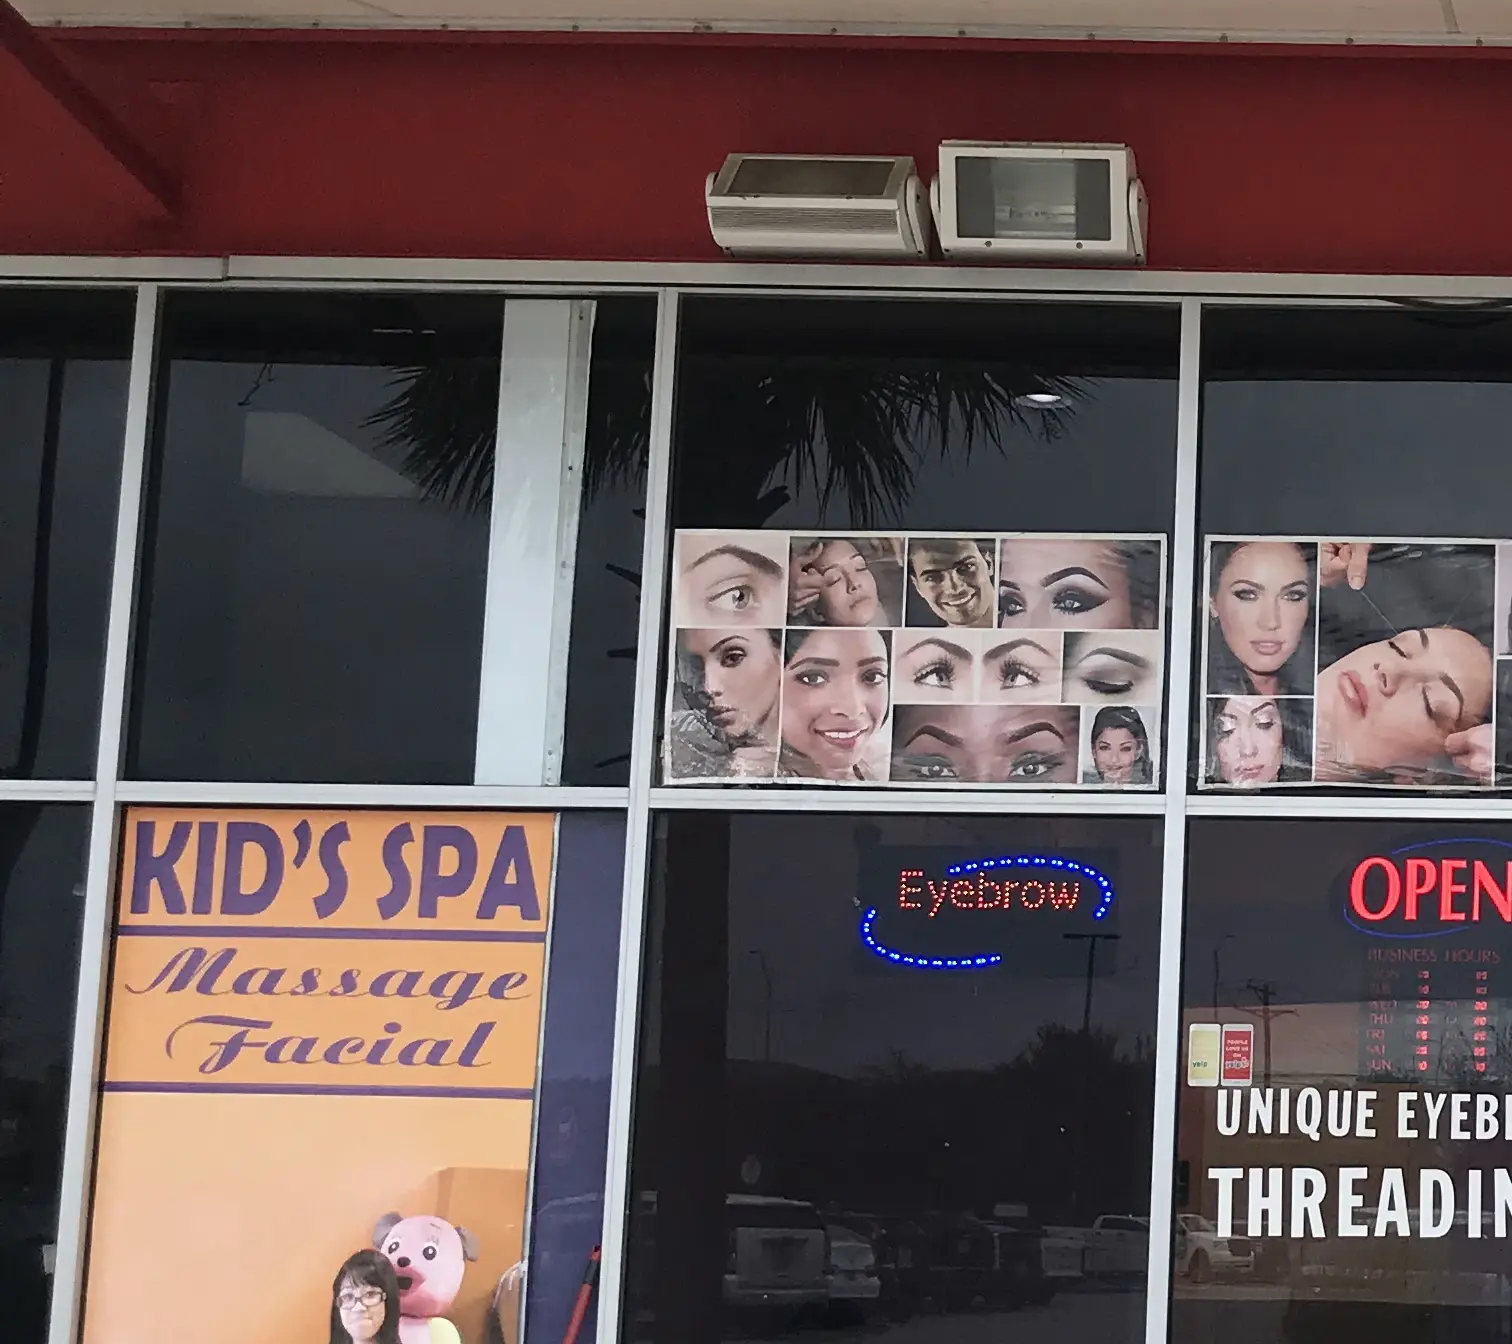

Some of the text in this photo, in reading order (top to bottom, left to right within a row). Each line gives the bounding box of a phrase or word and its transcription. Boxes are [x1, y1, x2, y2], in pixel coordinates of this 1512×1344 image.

[130, 819, 542, 921] KID'S SPA
[900, 868, 1080, 919] Eyebrow
[124, 947, 532, 1011] Massage
[165, 1014, 498, 1075] Facial
[1216, 1087, 1378, 1143] UNIQUE
